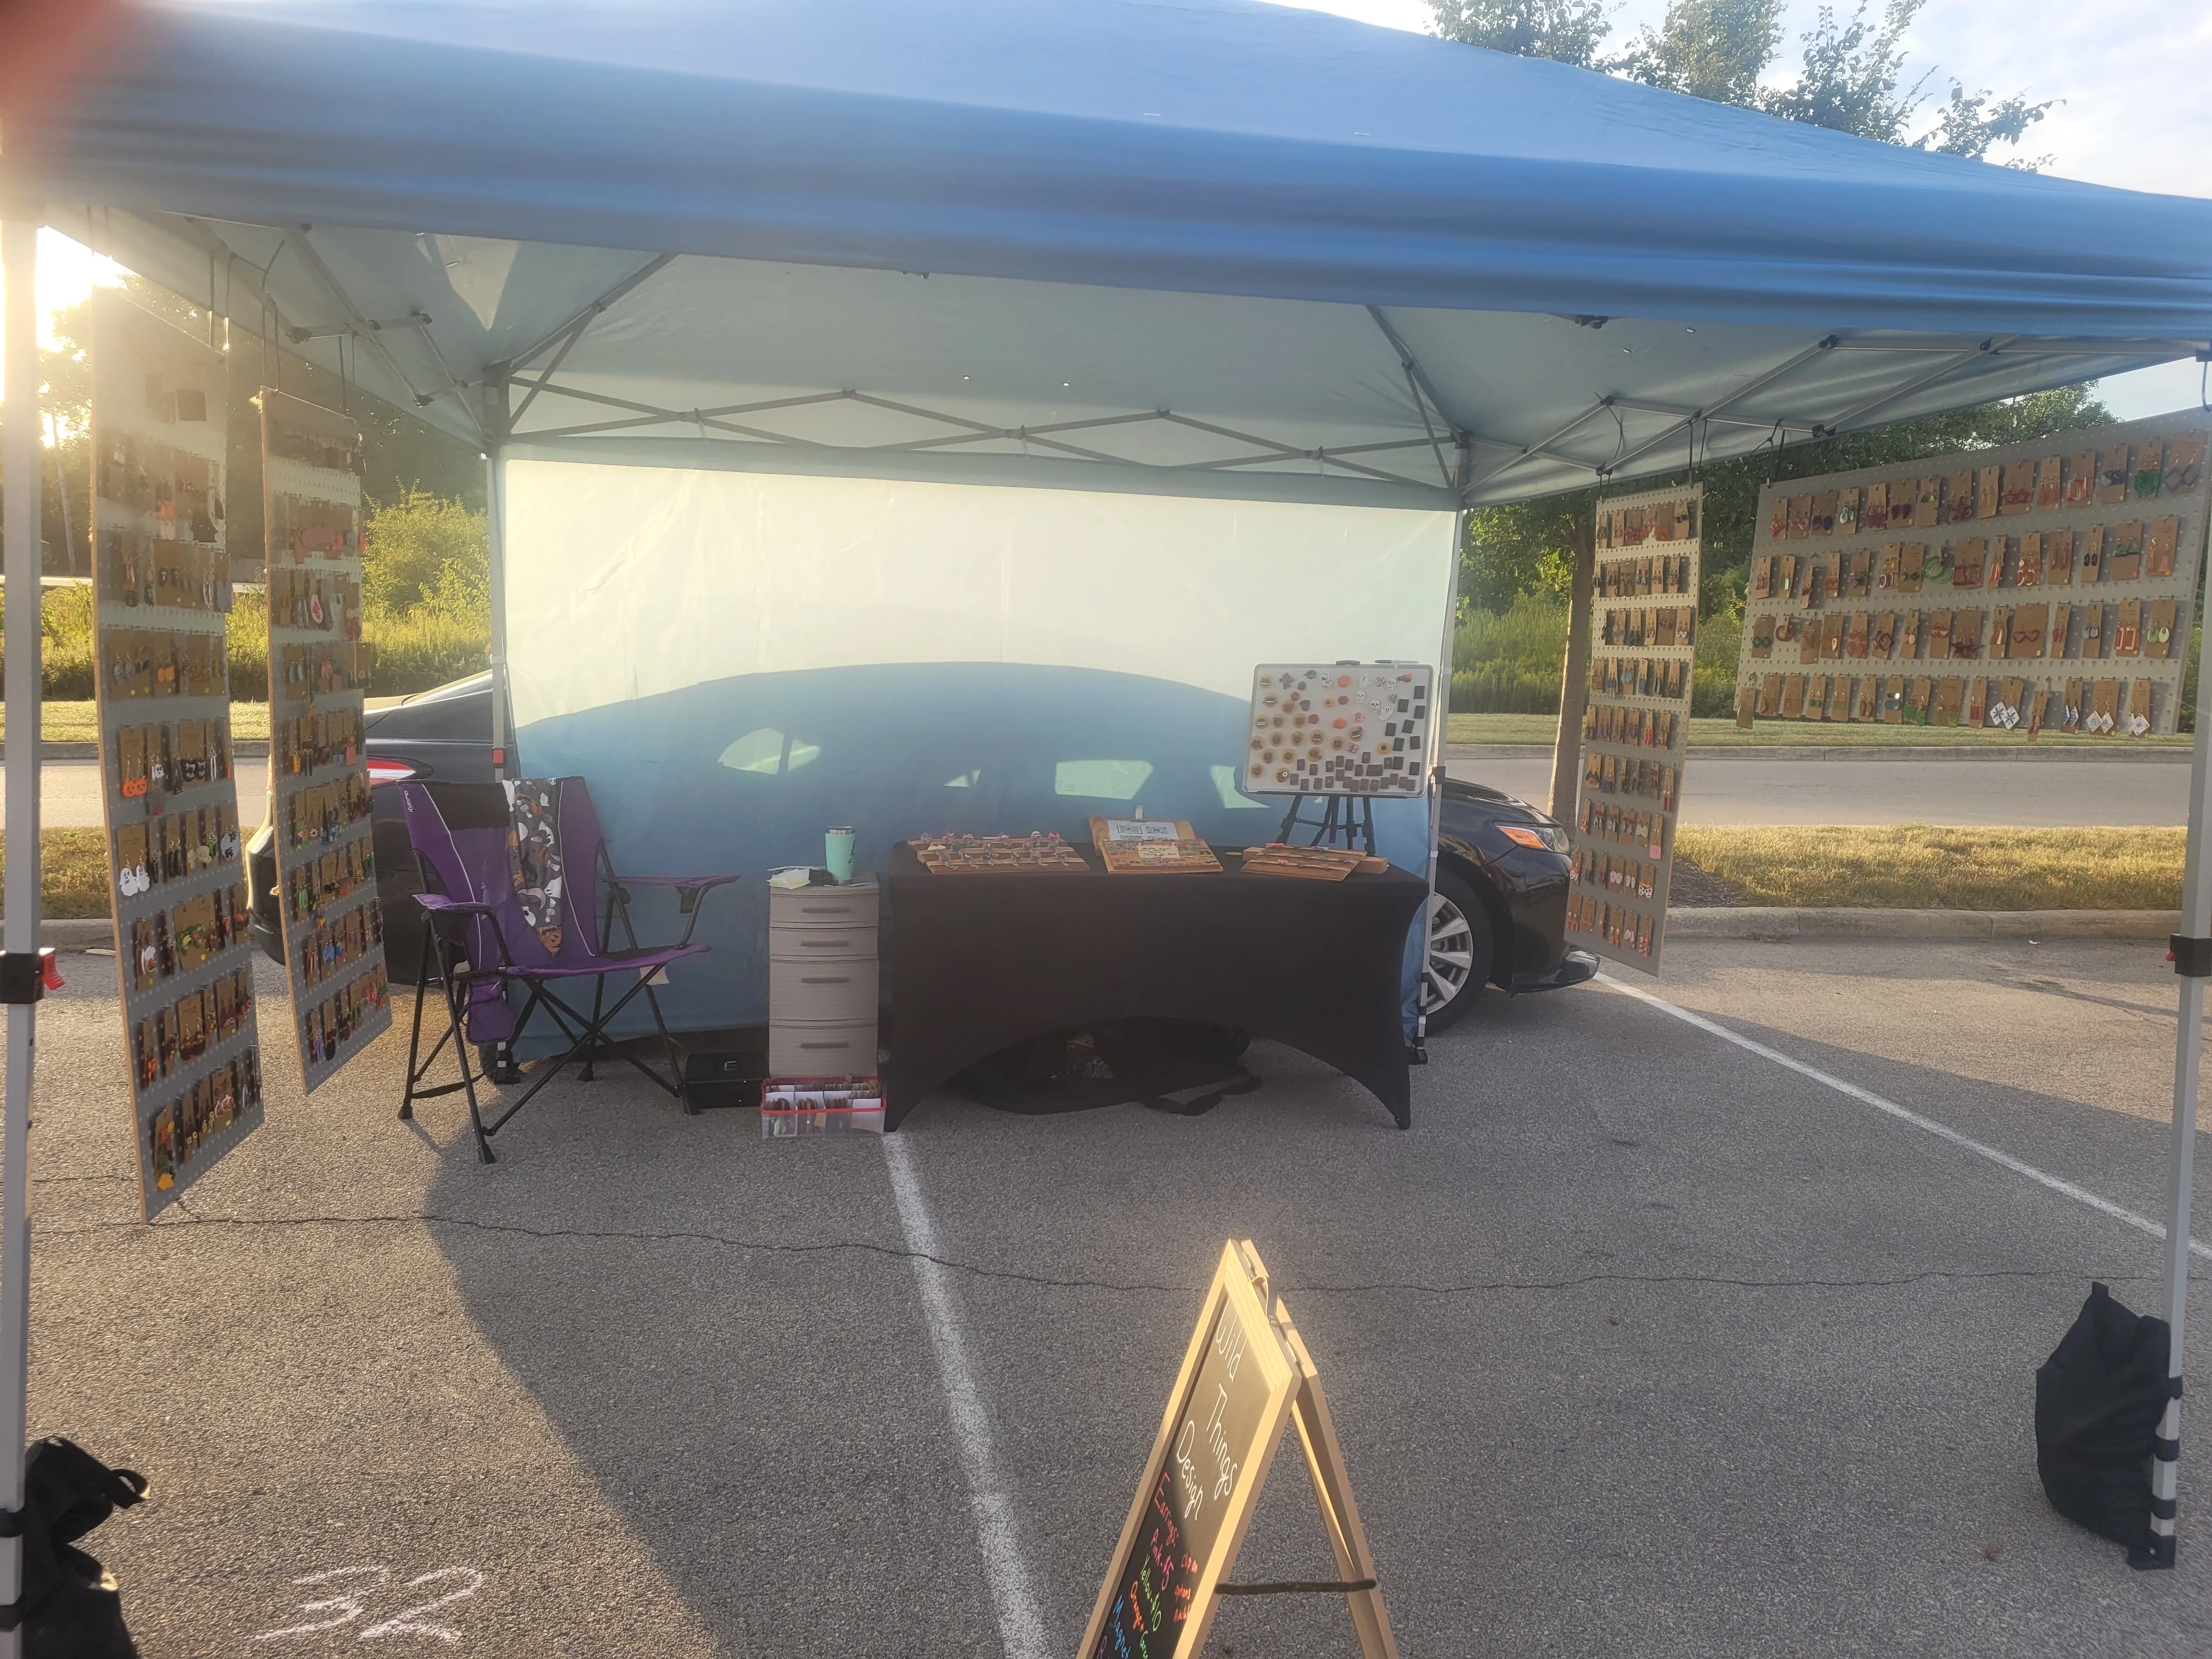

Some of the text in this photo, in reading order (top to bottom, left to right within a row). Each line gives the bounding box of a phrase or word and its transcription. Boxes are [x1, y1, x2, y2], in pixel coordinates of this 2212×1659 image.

[1216, 1297, 1248, 1383] Wild
[1176, 1420, 1203, 1521] Design
[1206, 1382, 1238, 1500] Things
[1154, 1471, 1179, 1547] Earrings:
